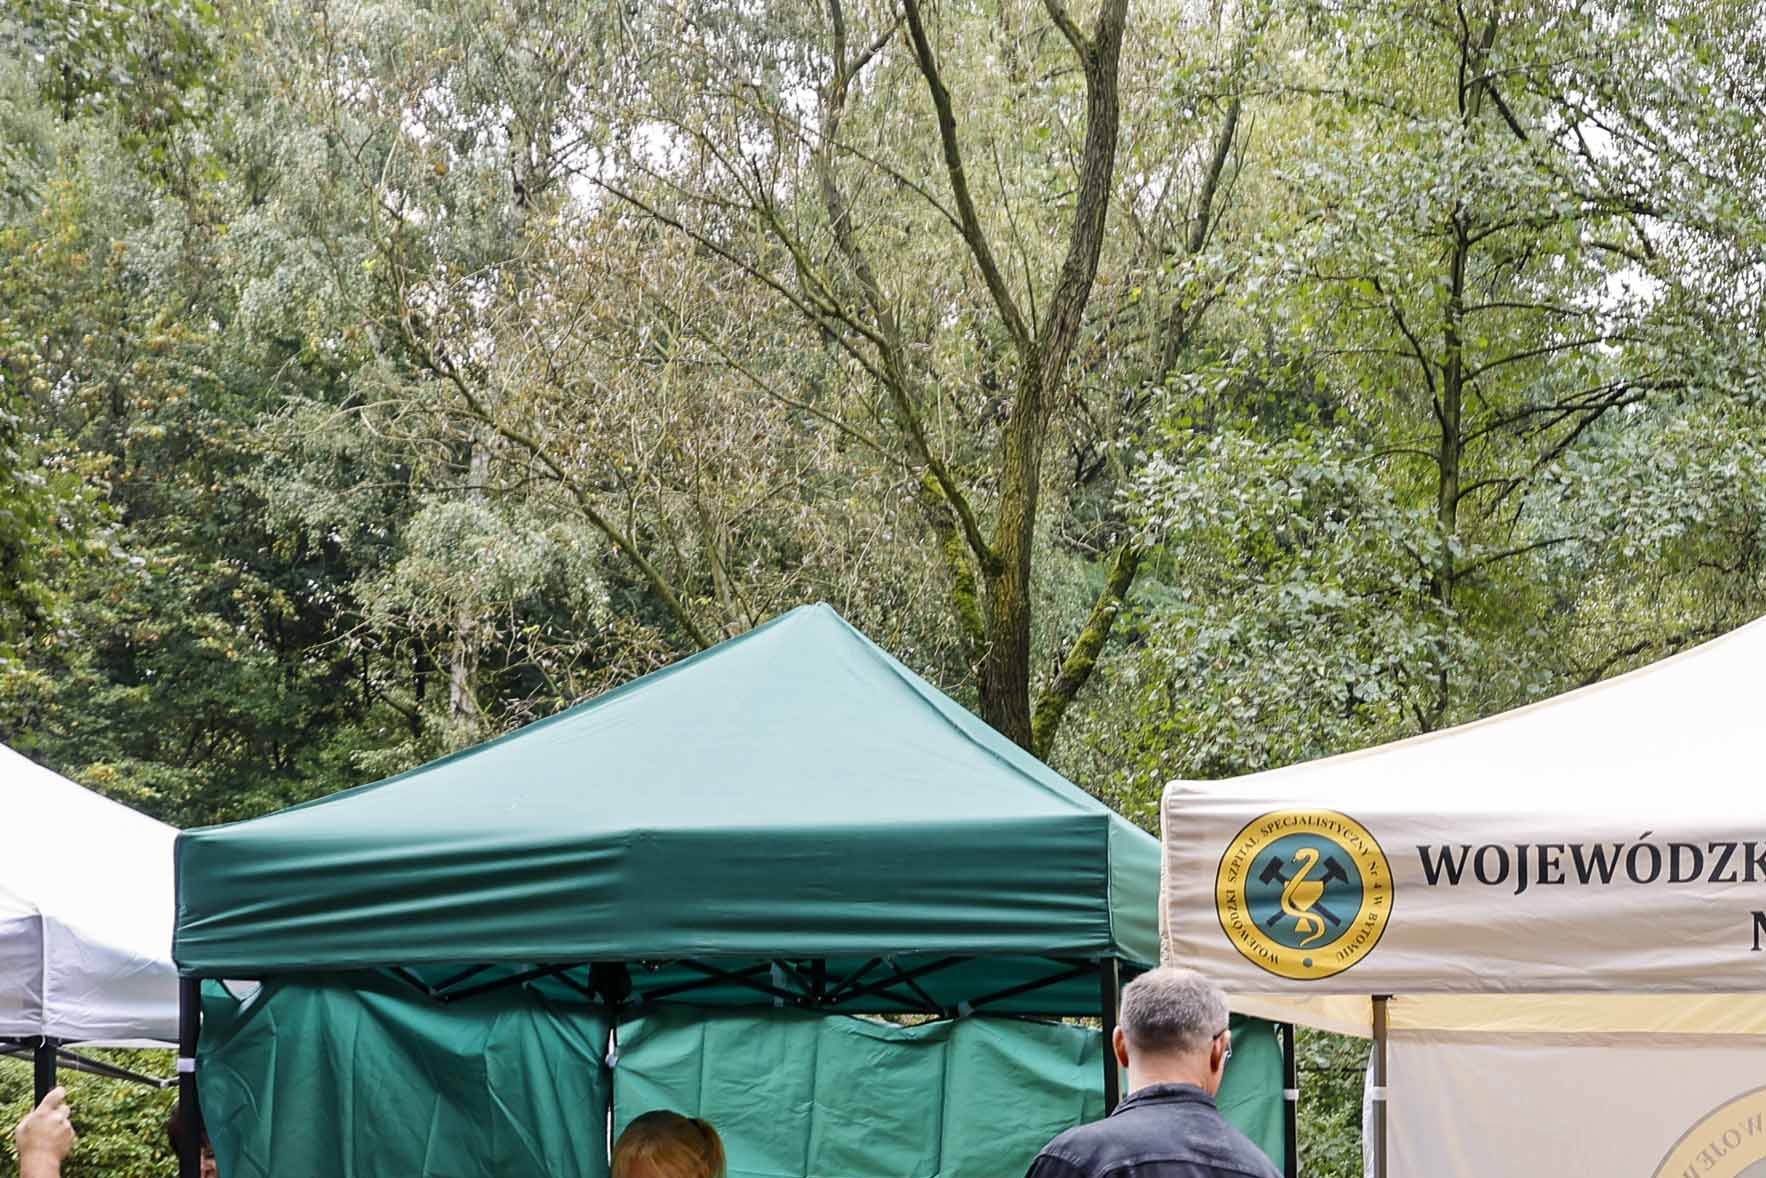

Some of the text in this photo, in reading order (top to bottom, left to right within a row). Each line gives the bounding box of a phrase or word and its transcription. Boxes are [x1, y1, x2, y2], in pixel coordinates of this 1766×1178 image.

[1228, 836, 1260, 883] SZPITAL
[1260, 815, 1369, 857] SPECJALISTYCZNY
[1226, 889, 1280, 965] WOJEWÓDZKI
[1336, 911, 1379, 963] BYTOMIU
